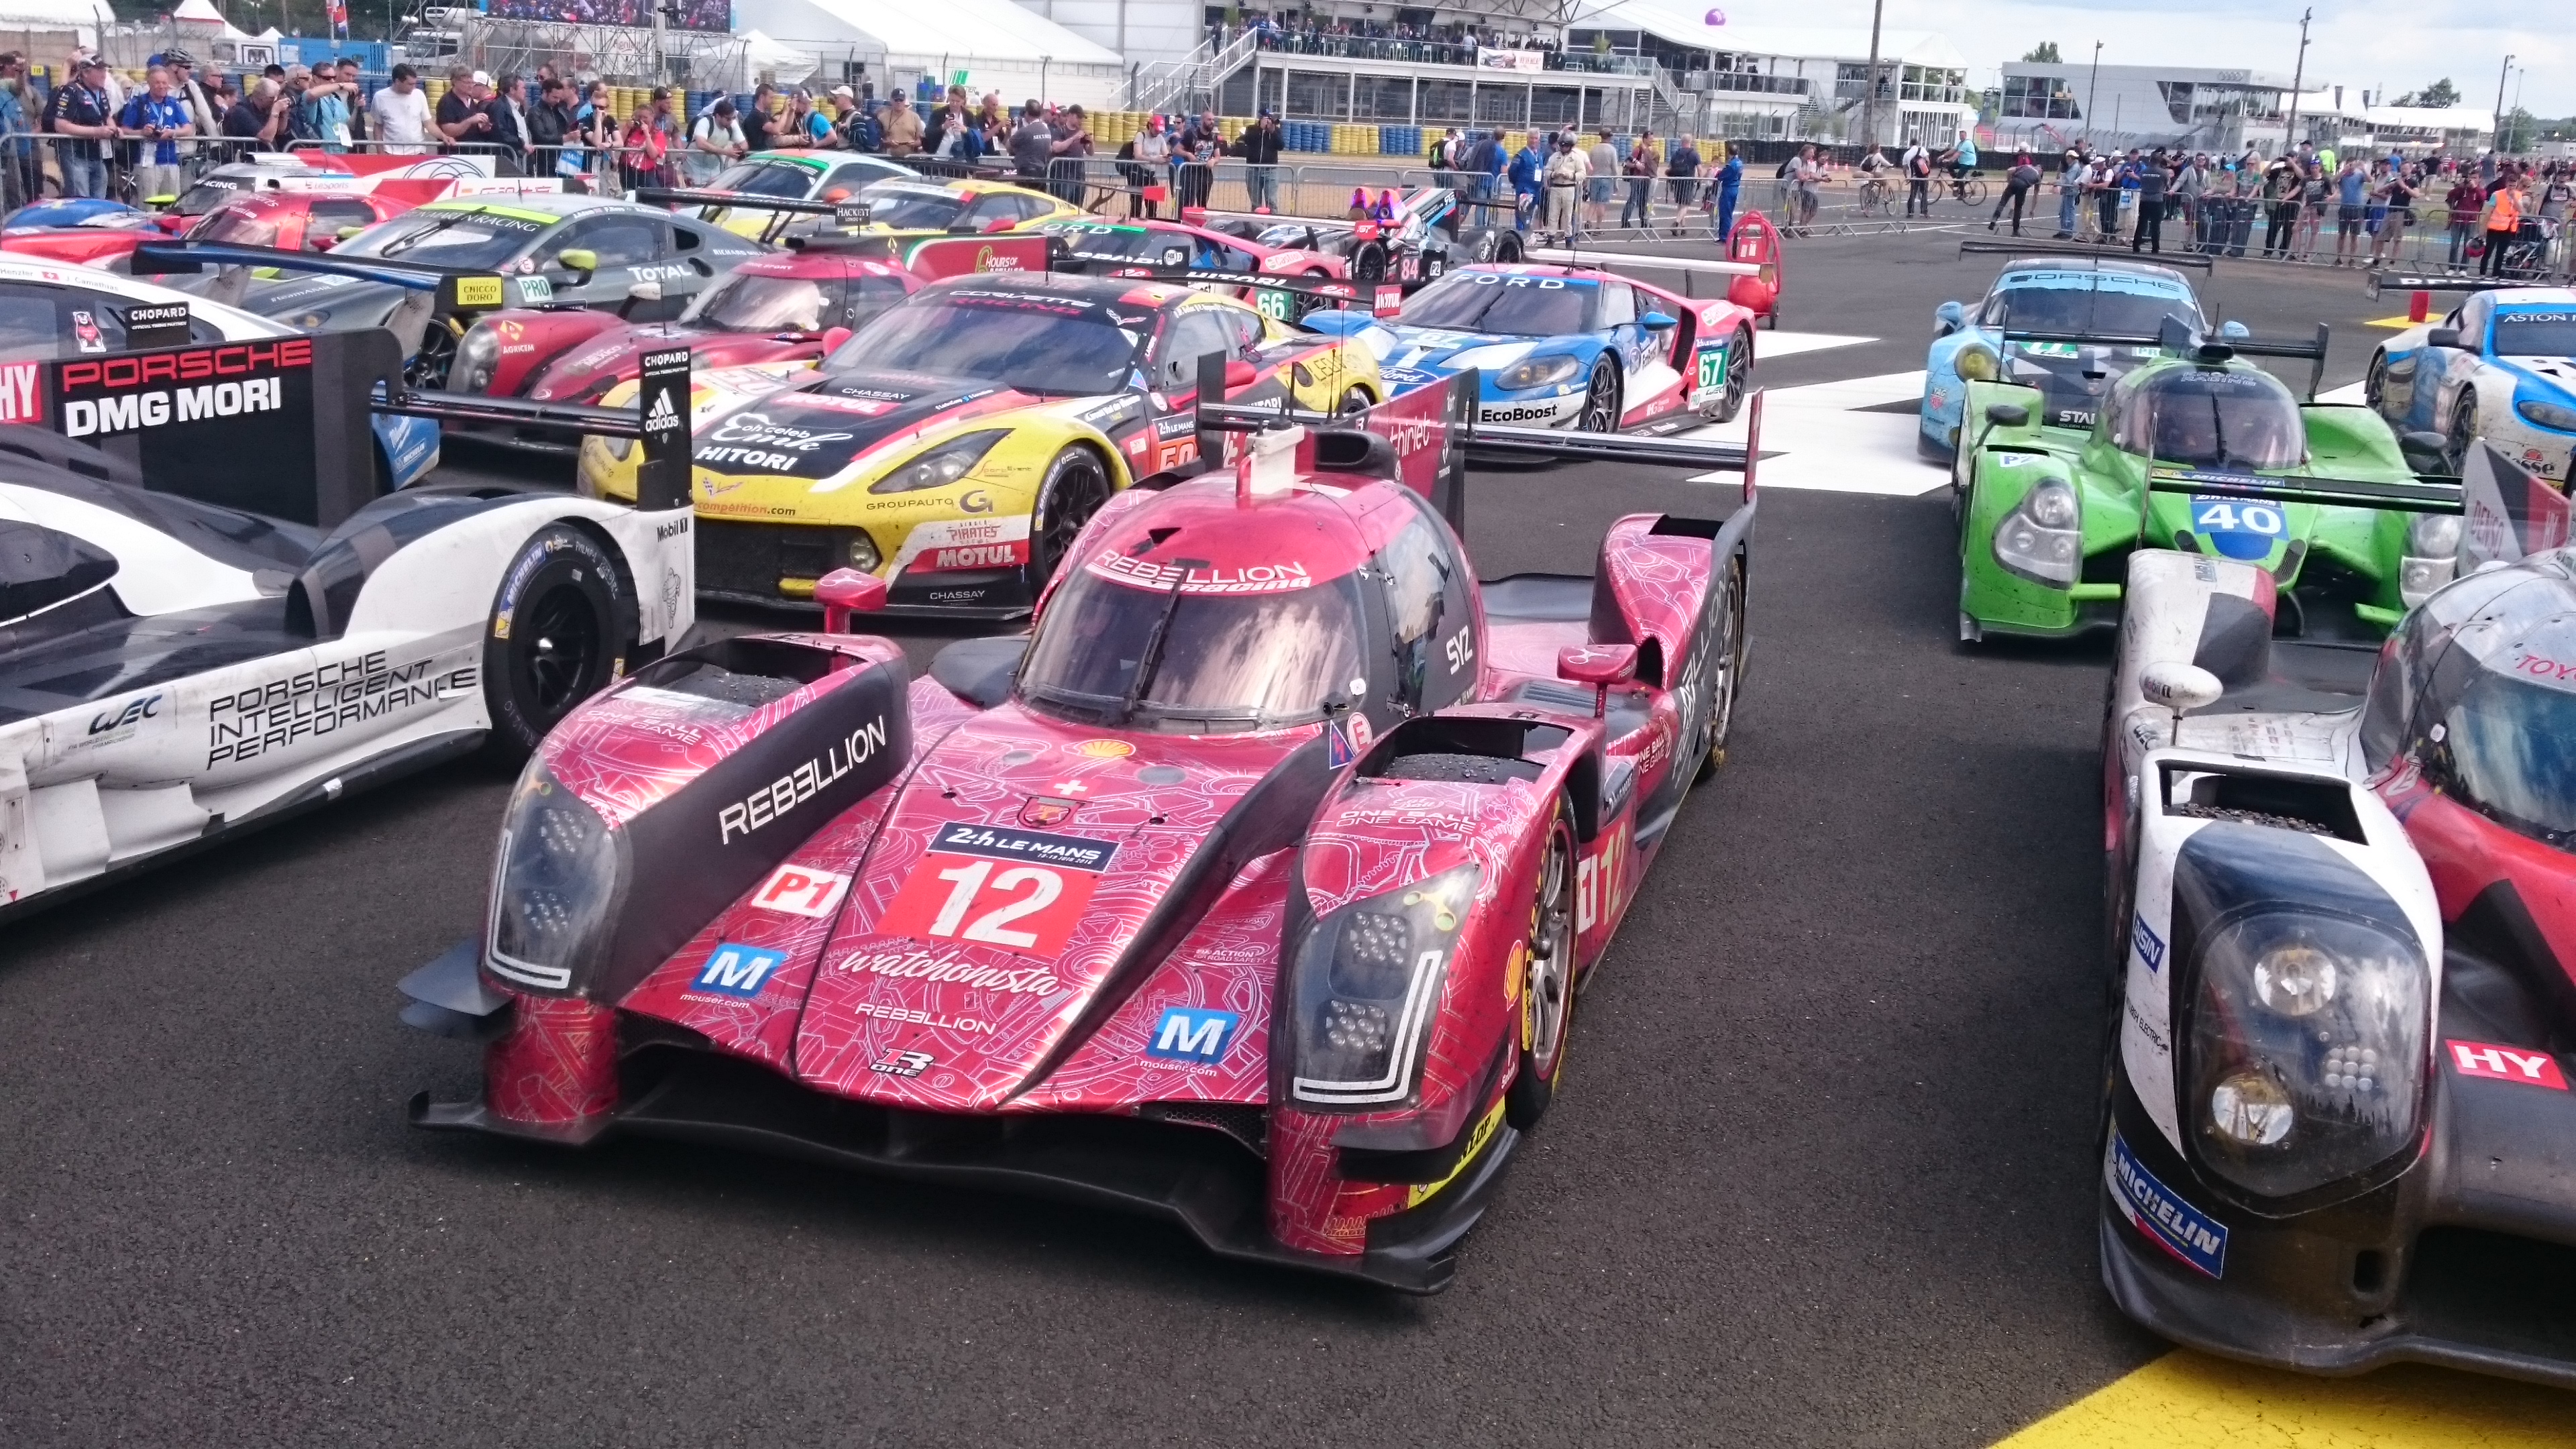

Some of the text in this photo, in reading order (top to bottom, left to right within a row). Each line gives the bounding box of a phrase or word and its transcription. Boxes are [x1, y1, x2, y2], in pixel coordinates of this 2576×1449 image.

[477, 214, 541, 233] RACING
[986, 254, 1010, 268] HOURS
[1401, 258, 1419, 280] 84
[1431, 263, 1440, 274] P2
[626, 264, 692, 282] TOTAL
[1185, 271, 1287, 286] HITORI
[1451, 273, 1565, 290] FORD
[2009, 274, 2180, 292] PORSCHE
[523, 279, 550, 298] PRO
[950, 290, 1096, 308] CORVETTE
[131, 306, 186, 320] CHOPARD
[1256, 292, 1285, 320] 66
[2504, 313, 2566, 323] ASTON
[502, 343, 535, 355] AGRICEM
[644, 351, 689, 367] CHOPARD
[63, 339, 313, 392] PORSCHE
[1699, 353, 1723, 388] 67
[842, 387, 911, 399] CHASSAY
[67, 377, 282, 437] DMG MORI
[1481, 403, 1558, 423] EcoBoost
[645, 413, 680, 432] adidas
[741, 423, 811, 439] oh celeb
[1178, 421, 1195, 431] MANS
[694, 446, 798, 472] HITORI
[1159, 442, 1196, 472] 50
[1039, 462, 1061, 511] MICHELIN
[2190, 474, 2282, 487] MICHELIN
[866, 498, 955, 511] GROUPAUTO
[2198, 503, 2282, 535] 40
[657, 523, 679, 543] Mobil
[946, 524, 1002, 541] PIRATES
[936, 544, 1016, 568] MOTUL
[506, 546, 543, 604] MICHELIN
[1095, 549, 1307, 586] REBELLION
[929, 590, 985, 600] CHASSAY
[1446, 625, 1474, 676] SYZ
[2516, 654, 2576, 680] TOY
[209, 648, 386, 722] PORSCHE
[209, 659, 433, 747] INTELLIGENT
[87, 694, 163, 736] WEC
[207, 666, 478, 771] PERFORMANCE
[631, 721, 700, 747] GAME
[643, 718, 702, 739] BALL
[1639, 745, 1651, 763] NE
[1638, 759, 1650, 776] NE
[718, 714, 887, 845] REBELLION
[1336, 815, 1476, 835] ONE GAME
[1340, 810, 1477, 826] ONE BALL
[945, 827, 1102, 861] 24h LE MANS
[762, 872, 839, 910] P1
[927, 860, 1065, 949] 12
[2133, 920, 2161, 964] AISIN
[1212, 950, 1254, 958] ACTION
[700, 951, 774, 990] M
[839, 947, 1069, 998] watchonista
[679, 993, 750, 1010] mouser.com
[855, 1002, 998, 1036] REBELLION
[1156, 1014, 1228, 1056] M
[2139, 1016, 2161, 1047] ELECTRIC
[870, 1063, 920, 1077] ONE
[1139, 1059, 1218, 1077] mouser.com
[2454, 1044, 2547, 1081] HY
[2115, 1155, 2222, 1256] MICHELIN
